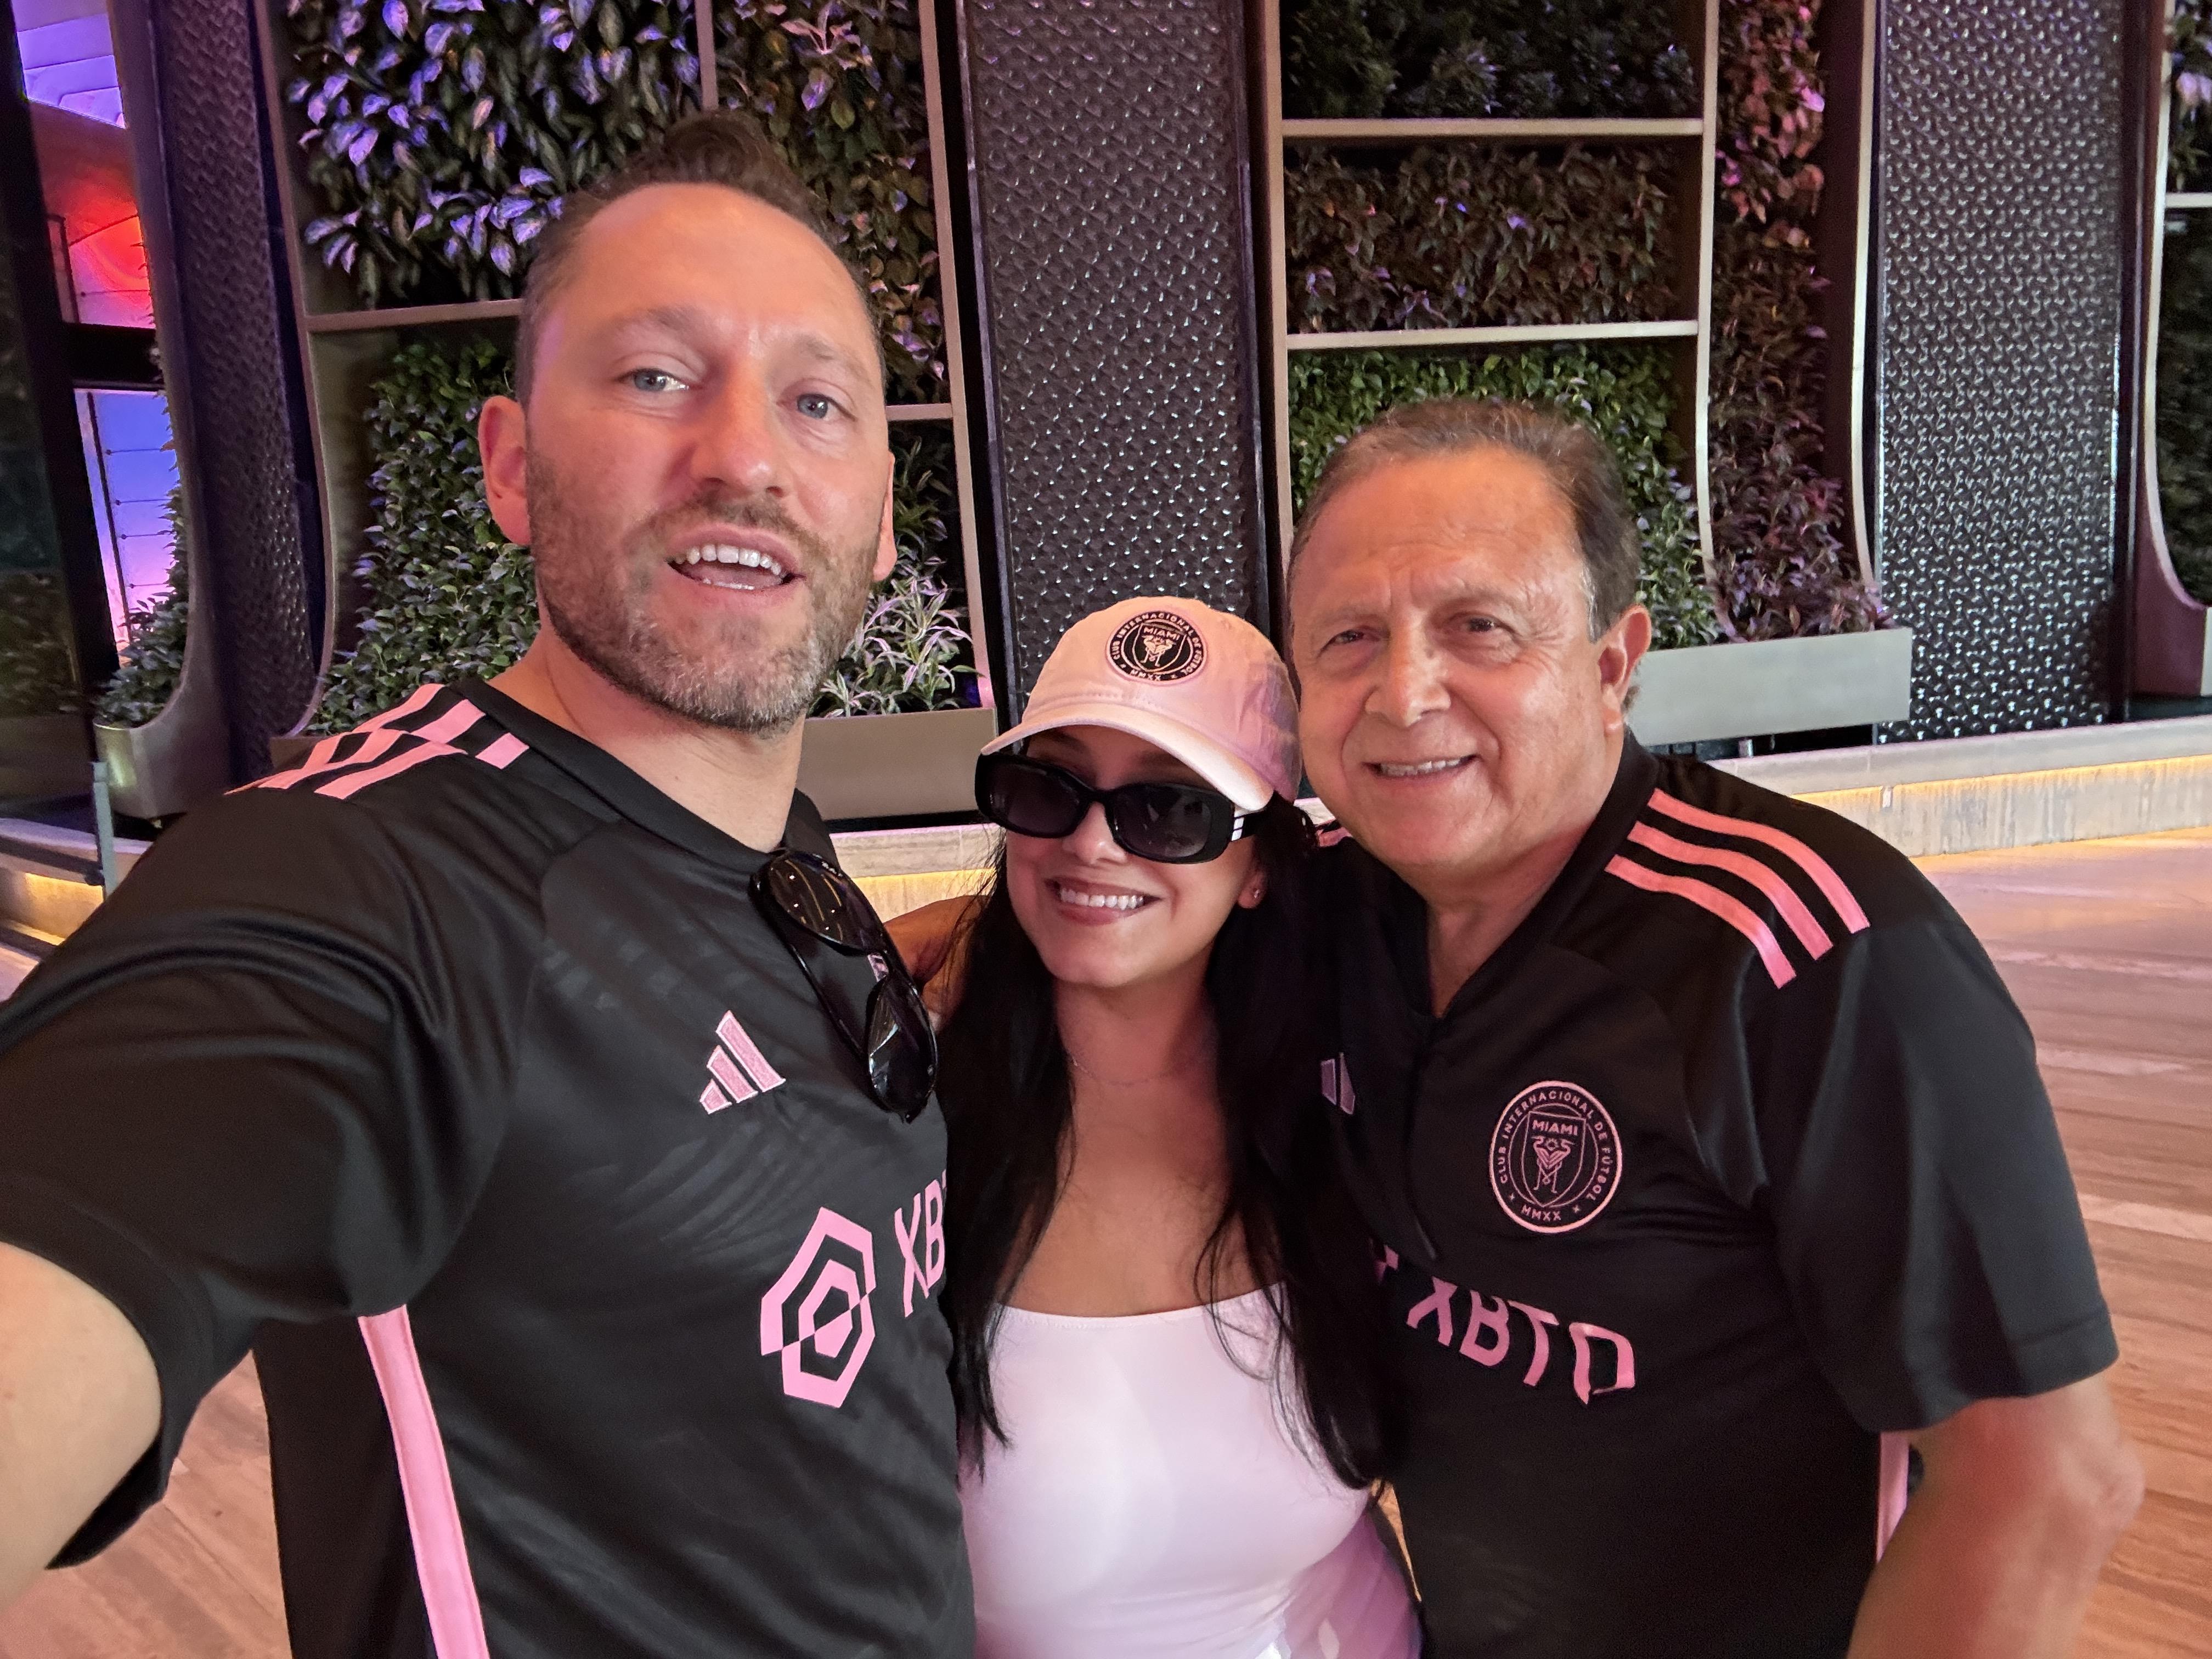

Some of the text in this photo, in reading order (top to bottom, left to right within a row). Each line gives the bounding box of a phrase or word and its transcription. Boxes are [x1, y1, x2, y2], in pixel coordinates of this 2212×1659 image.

[1111, 640, 1121, 660] CLUB
[1116, 612, 1194, 639] INTERNACIONAL
[1143, 627, 1180, 641] MIAMI
[1130, 668, 1161, 681] MMXX
[1502, 1091, 1593, 1139] INTERNACIONAL
[1532, 1120, 1578, 1136] MIAMI
[1497, 1146, 1508, 1184] CLUB
[1520, 1204, 1562, 1221] MMXX
[894, 1169, 947, 1318] XB
